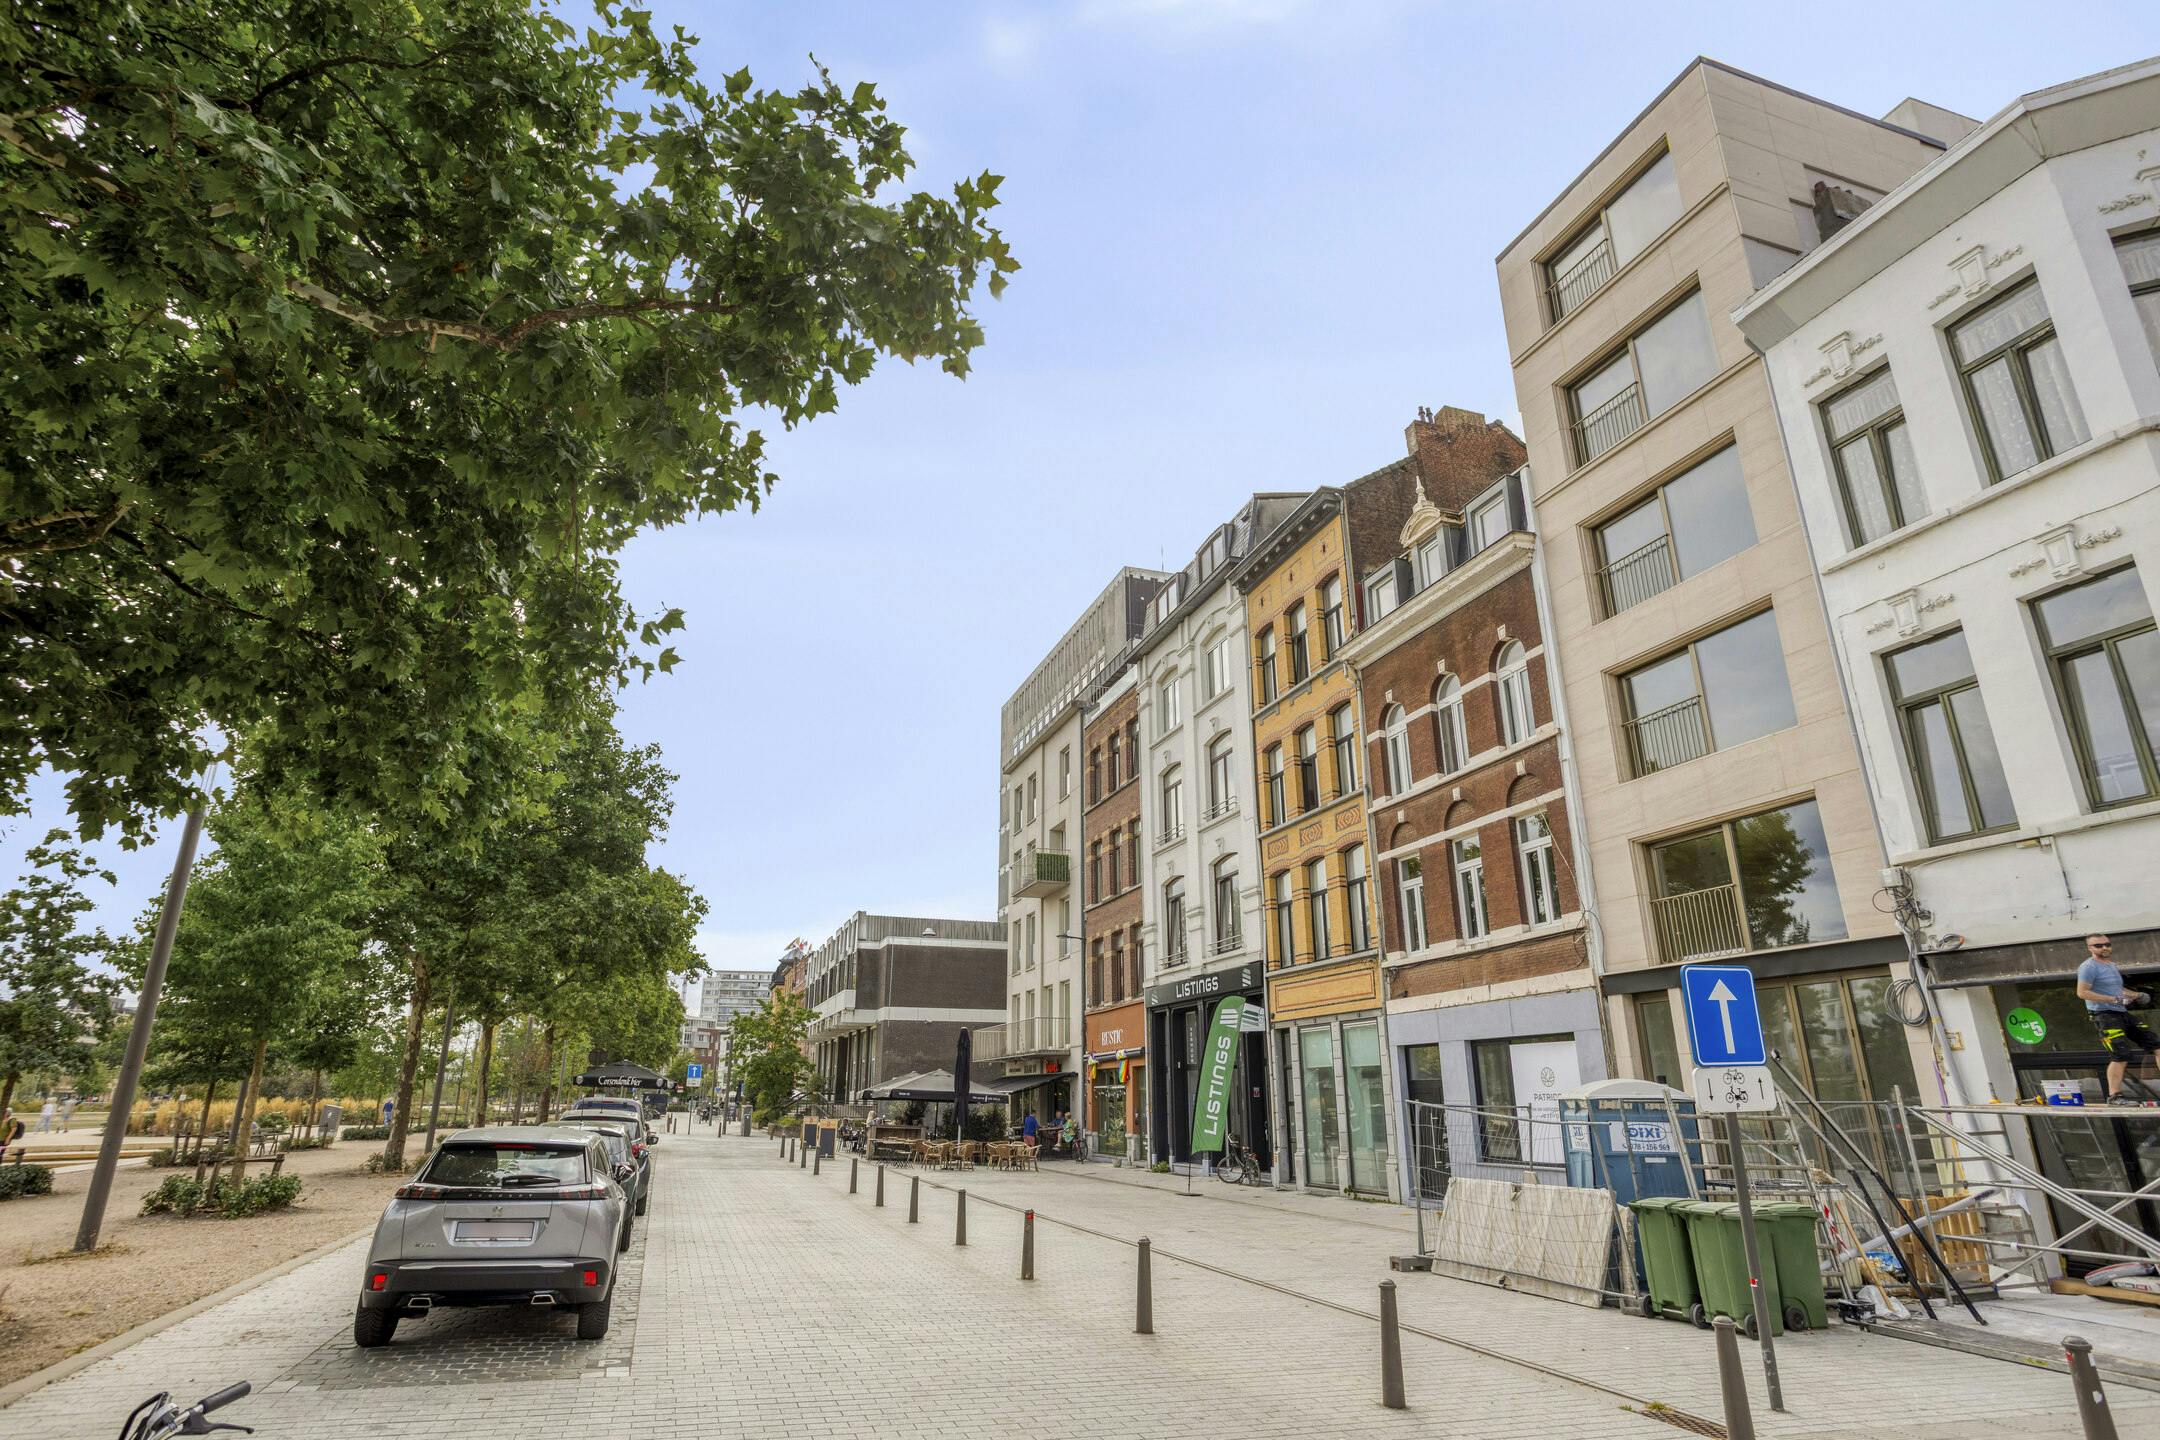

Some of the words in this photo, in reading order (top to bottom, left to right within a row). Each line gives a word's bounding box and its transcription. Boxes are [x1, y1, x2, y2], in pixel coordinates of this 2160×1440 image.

[1175, 976, 1219, 998] LISTINGS
[1101, 1028, 1123, 1047] RUSTIC
[1204, 1035, 1231, 1136] LISTINGS
